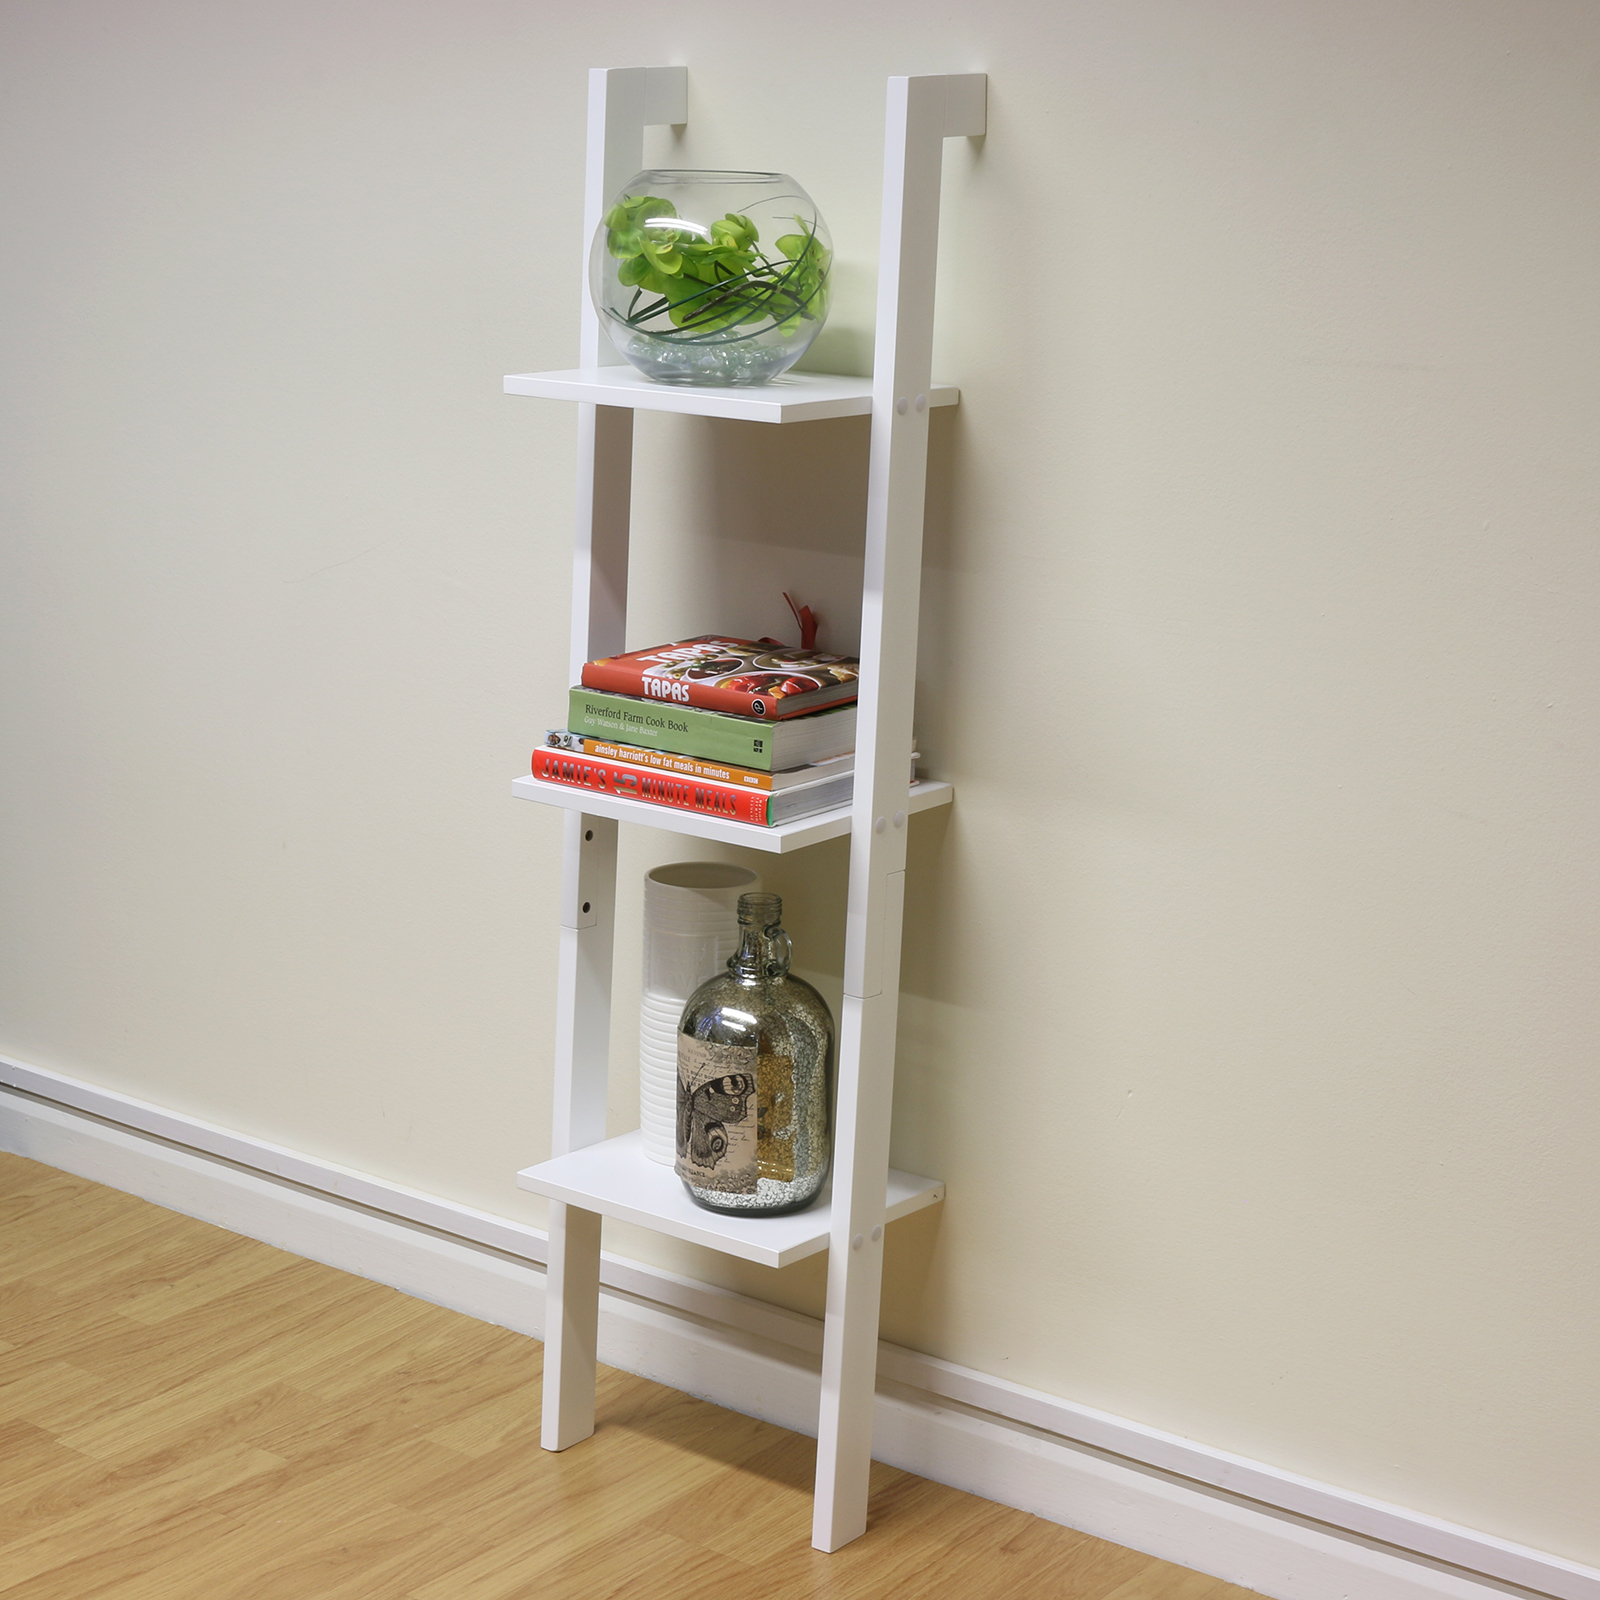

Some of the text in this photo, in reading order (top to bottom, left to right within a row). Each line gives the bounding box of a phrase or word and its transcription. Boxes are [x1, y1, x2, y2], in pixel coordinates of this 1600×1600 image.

[636, 640, 738, 663] TAPAS
[641, 676, 690, 702] TAPAS
[584, 716, 658, 737] Guy Watson & Jane Baxter
[585, 704, 689, 733] Riverford Farm Cook Book
[594, 743, 730, 780] ainsley harriott's low fat meals in minutes
[541, 758, 607, 789] JAMIE'S
[613, 771, 638, 794] 15
[641, 777, 690, 806] MINUTE
[694, 787, 737, 816] MEALS
